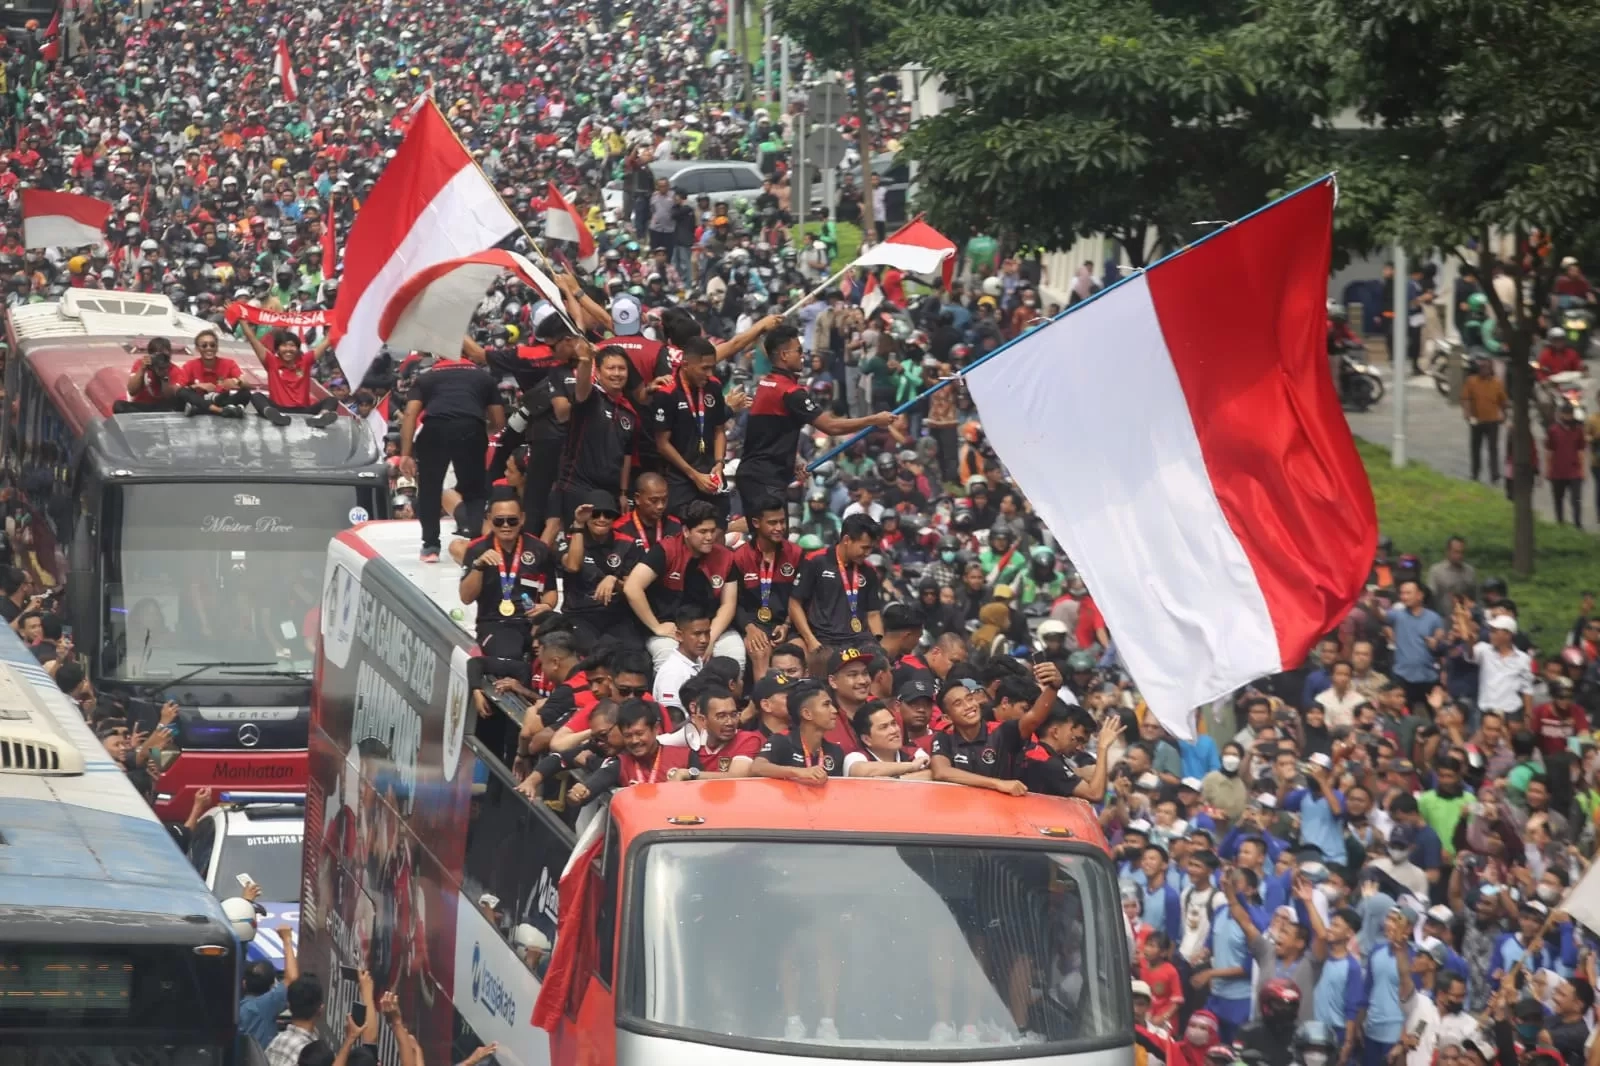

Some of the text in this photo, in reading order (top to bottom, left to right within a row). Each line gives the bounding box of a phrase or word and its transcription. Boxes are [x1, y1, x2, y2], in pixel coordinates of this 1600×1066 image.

[258, 310, 325, 325] INDONESIA
[200, 514, 252, 533] Master
[351, 513, 366, 521] CMC
[357, 586, 436, 705] SEA GAMES 2023
[217, 711, 280, 719] LEGACY
[212, 760, 294, 780] Manhattan
[247, 835, 297, 846] DITLANTAS
